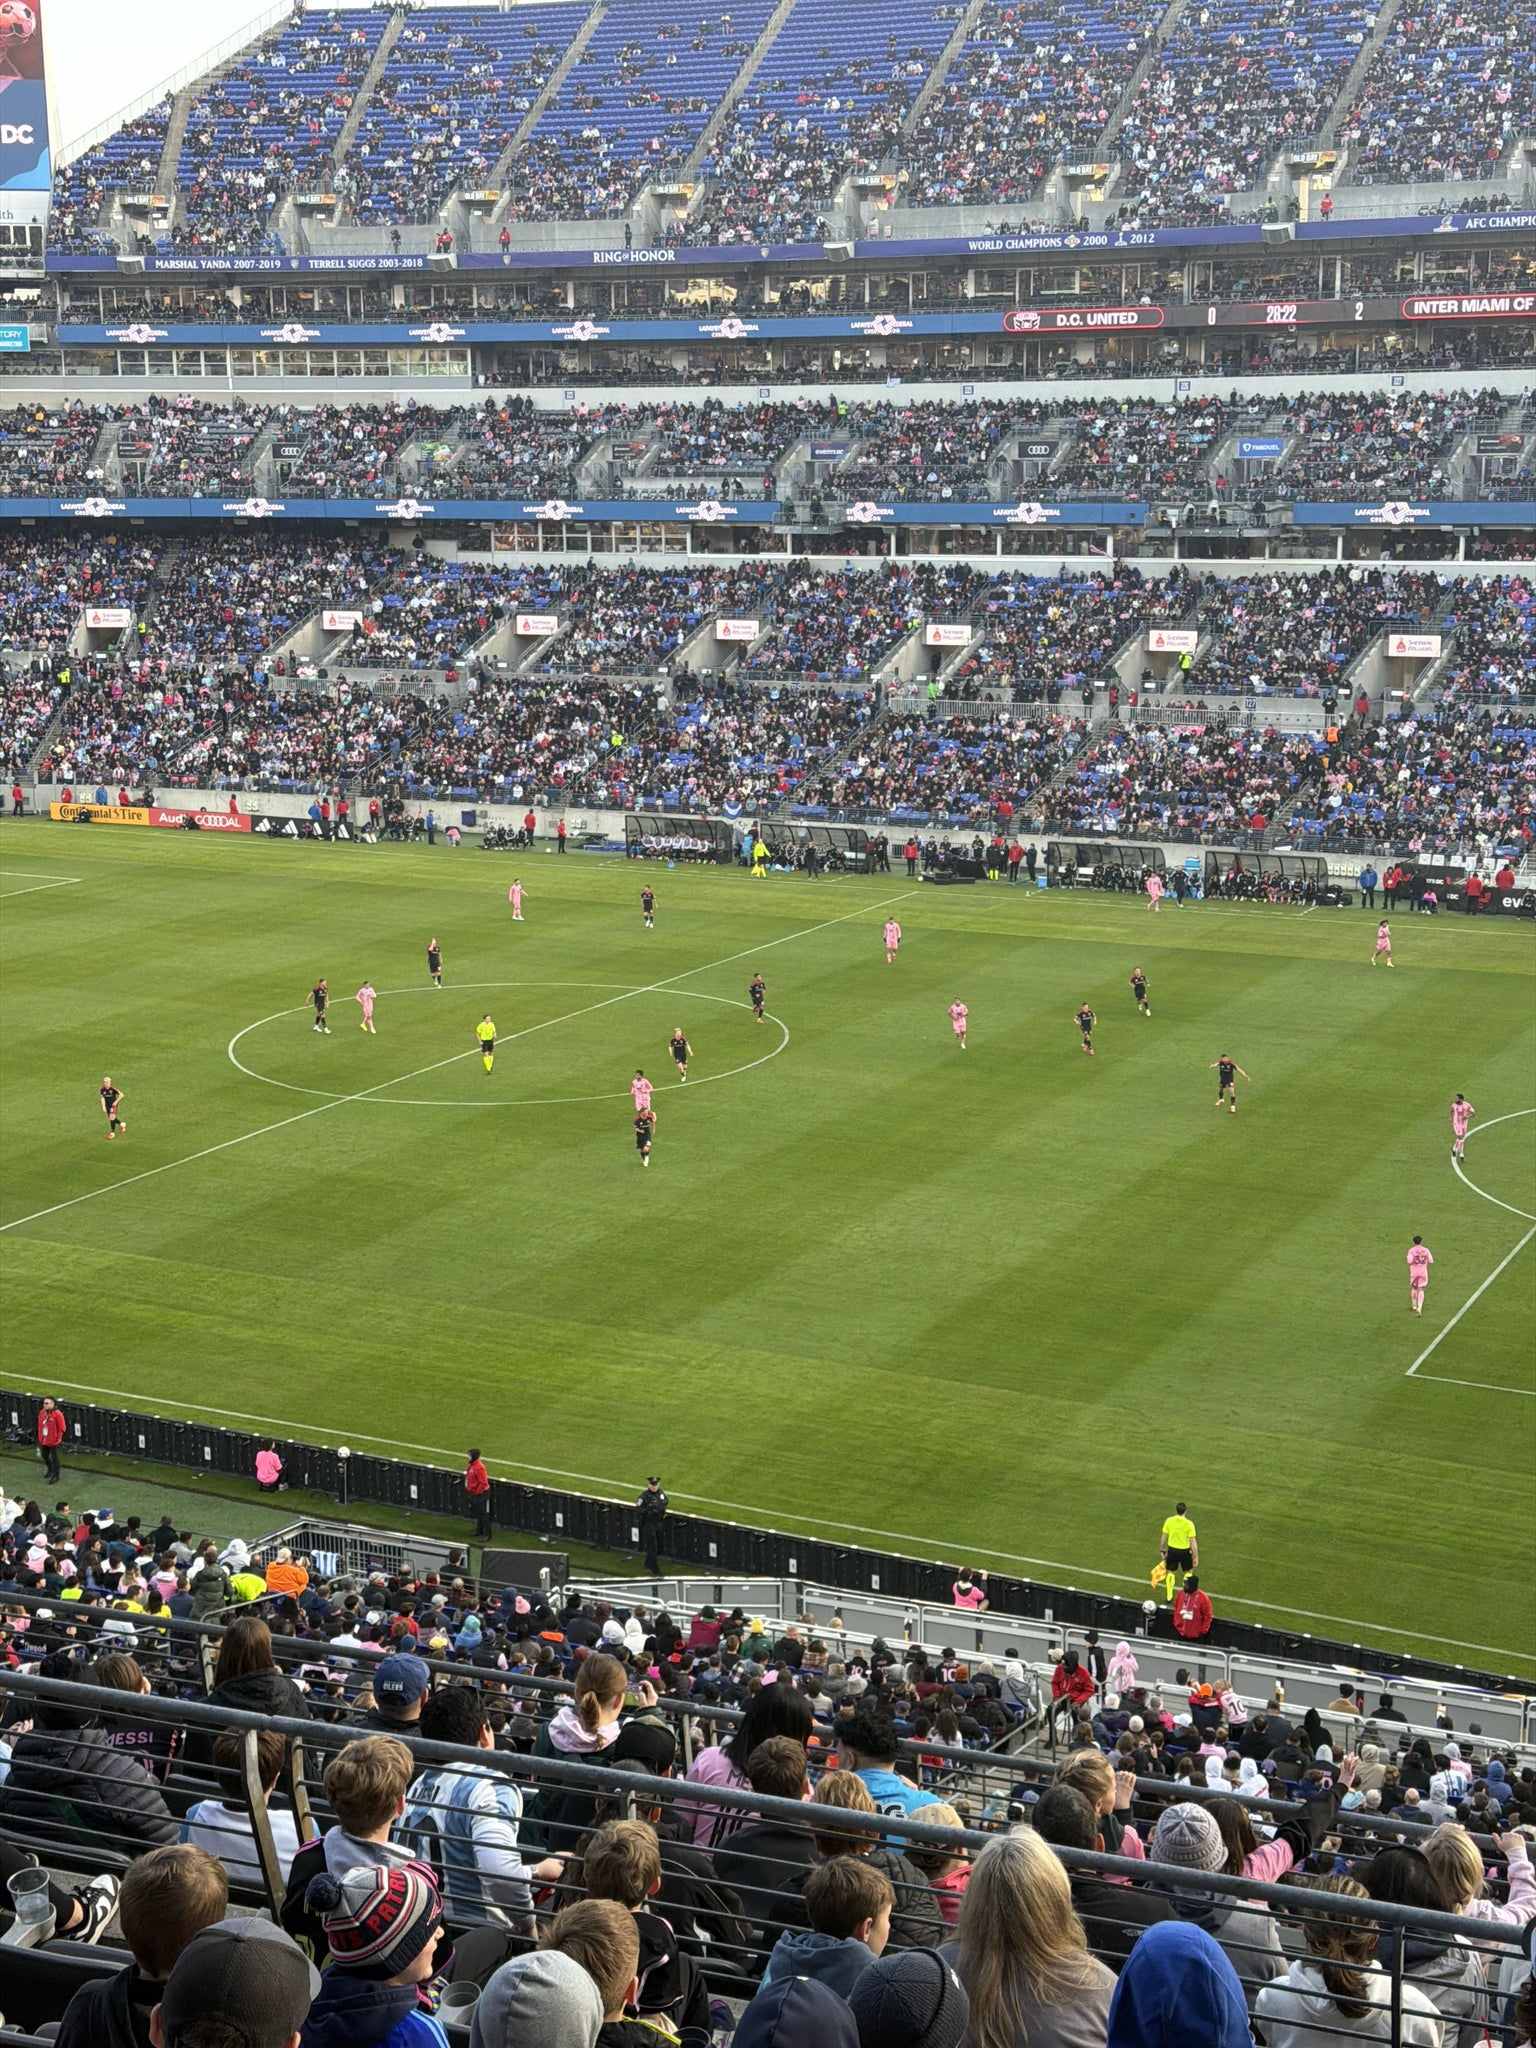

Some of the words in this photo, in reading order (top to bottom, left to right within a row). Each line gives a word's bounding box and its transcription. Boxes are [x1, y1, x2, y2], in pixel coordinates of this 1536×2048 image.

[1, 124, 34, 144] DC
[1466, 218, 1486, 229] AFC
[968, 240, 1002, 250] WORLD
[1006, 238, 1062, 250] CHAMPIONS
[1083, 236, 1108, 246] 2000
[1130, 234, 1155, 244] 2012
[308, 260, 346, 268] TERRELL
[348, 259, 376, 268] SUGGS
[378, 258, 423, 268] 2003-2018
[594, 252, 622, 263] RING
[630, 250, 675, 262] HONOR
[156, 260, 198, 269] MARSHAL
[200, 260, 231, 269] YANDA
[234, 260, 281, 269] 2007-2019
[1354, 302, 1364, 320] 2
[1414, 300, 1458, 314] INTER
[1462, 298, 1510, 312] MIAMI
[1513, 297, 1534, 310] CF
[1056, 315, 1084, 326] D.C.
[1086, 312, 1138, 325] UNITED
[1208, 307, 1216, 325] 0
[1266, 304, 1297, 323] 28:22
[120, 808, 142, 820] Tire
[1414, 1255, 1426, 1264] 32
[941, 1668, 956, 1682] 10
